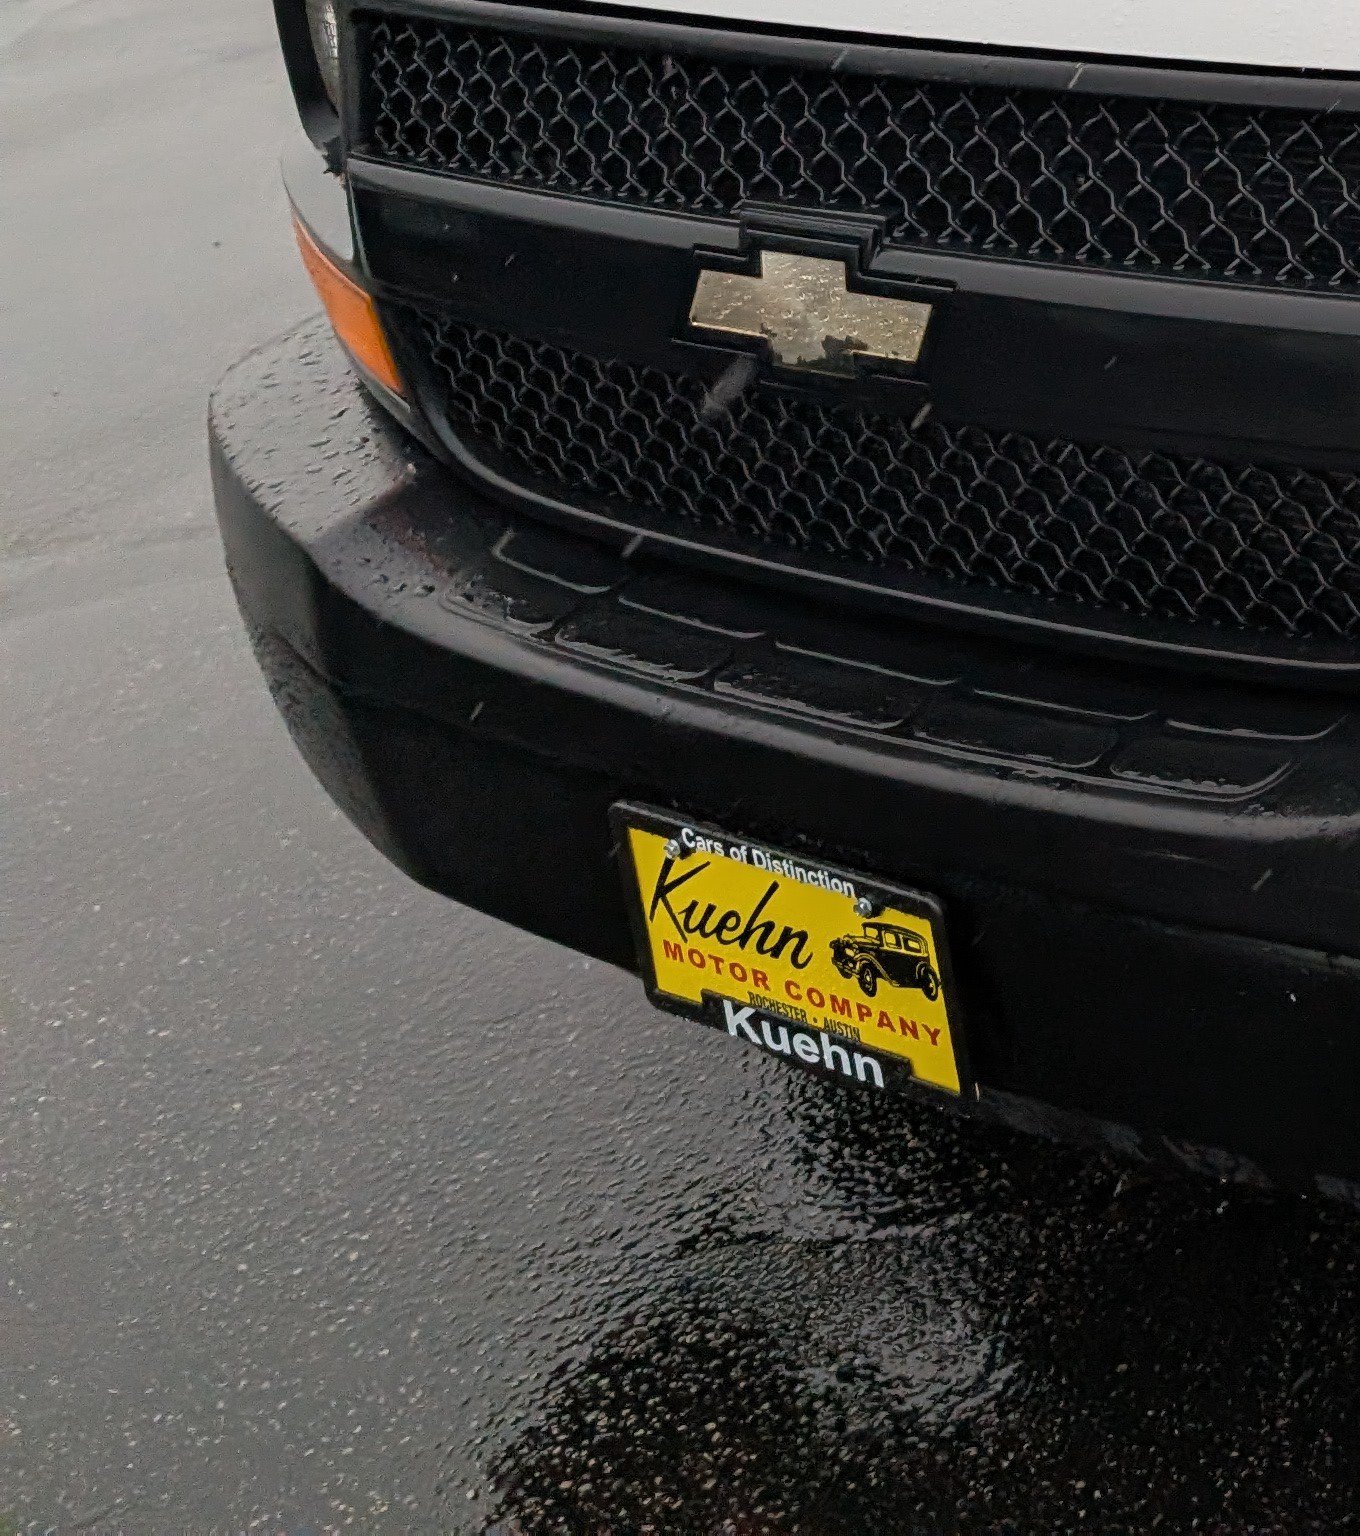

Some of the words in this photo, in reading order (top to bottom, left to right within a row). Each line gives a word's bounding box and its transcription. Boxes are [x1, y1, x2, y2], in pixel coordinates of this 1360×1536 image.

[681, 827, 725, 857] Cars
[729, 845, 748, 864] of
[752, 849, 855, 898] Distinction
[649, 856, 814, 969] Kuehn
[663, 940, 770, 991] MOTOR
[785, 980, 941, 1046] COMPANY
[748, 991, 808, 1023] ROCHESTER
[823, 1019, 862, 1042] AUSTIN
[722, 999, 885, 1089] Kuehn
